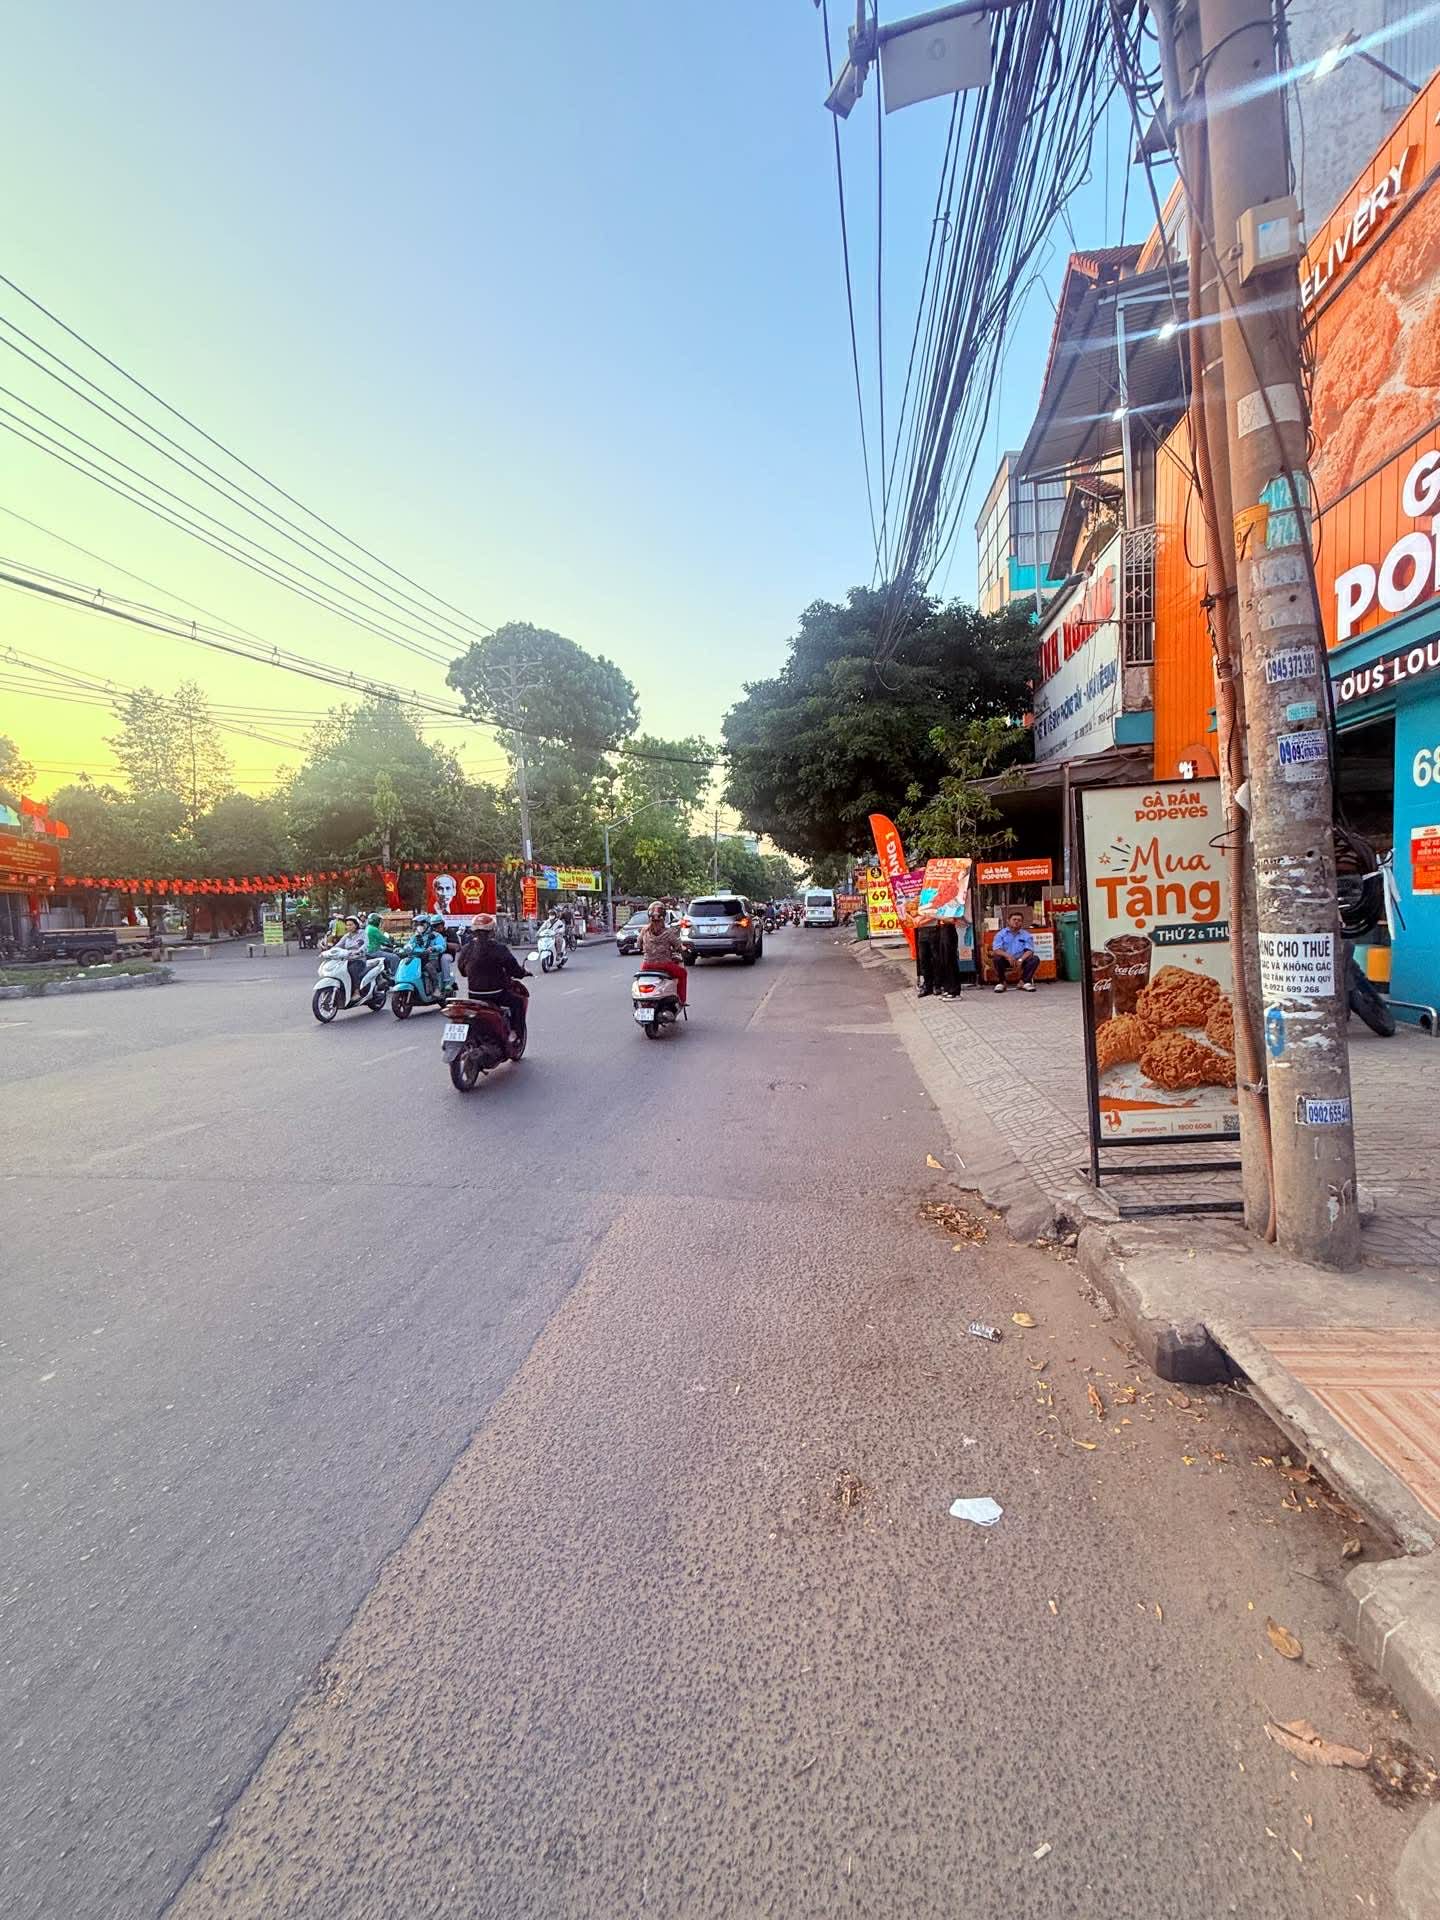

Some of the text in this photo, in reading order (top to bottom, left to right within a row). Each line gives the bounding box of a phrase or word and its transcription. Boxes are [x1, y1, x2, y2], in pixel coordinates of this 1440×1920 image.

[1335, 513, 1440, 642] PO
[1341, 664, 1384, 701] OUS
[1142, 788, 1200, 807] GÀ RÁN
[1129, 837, 1211, 879] Mua
[1095, 875, 1220, 929] Tặng
[1188, 930, 1196, 939] 2
[1277, 941, 1299, 957] CHO
[1302, 936, 1330, 958] THUÊ
[1305, 985, 1320, 993] 268
[1309, 1105, 1328, 1122] 0902
